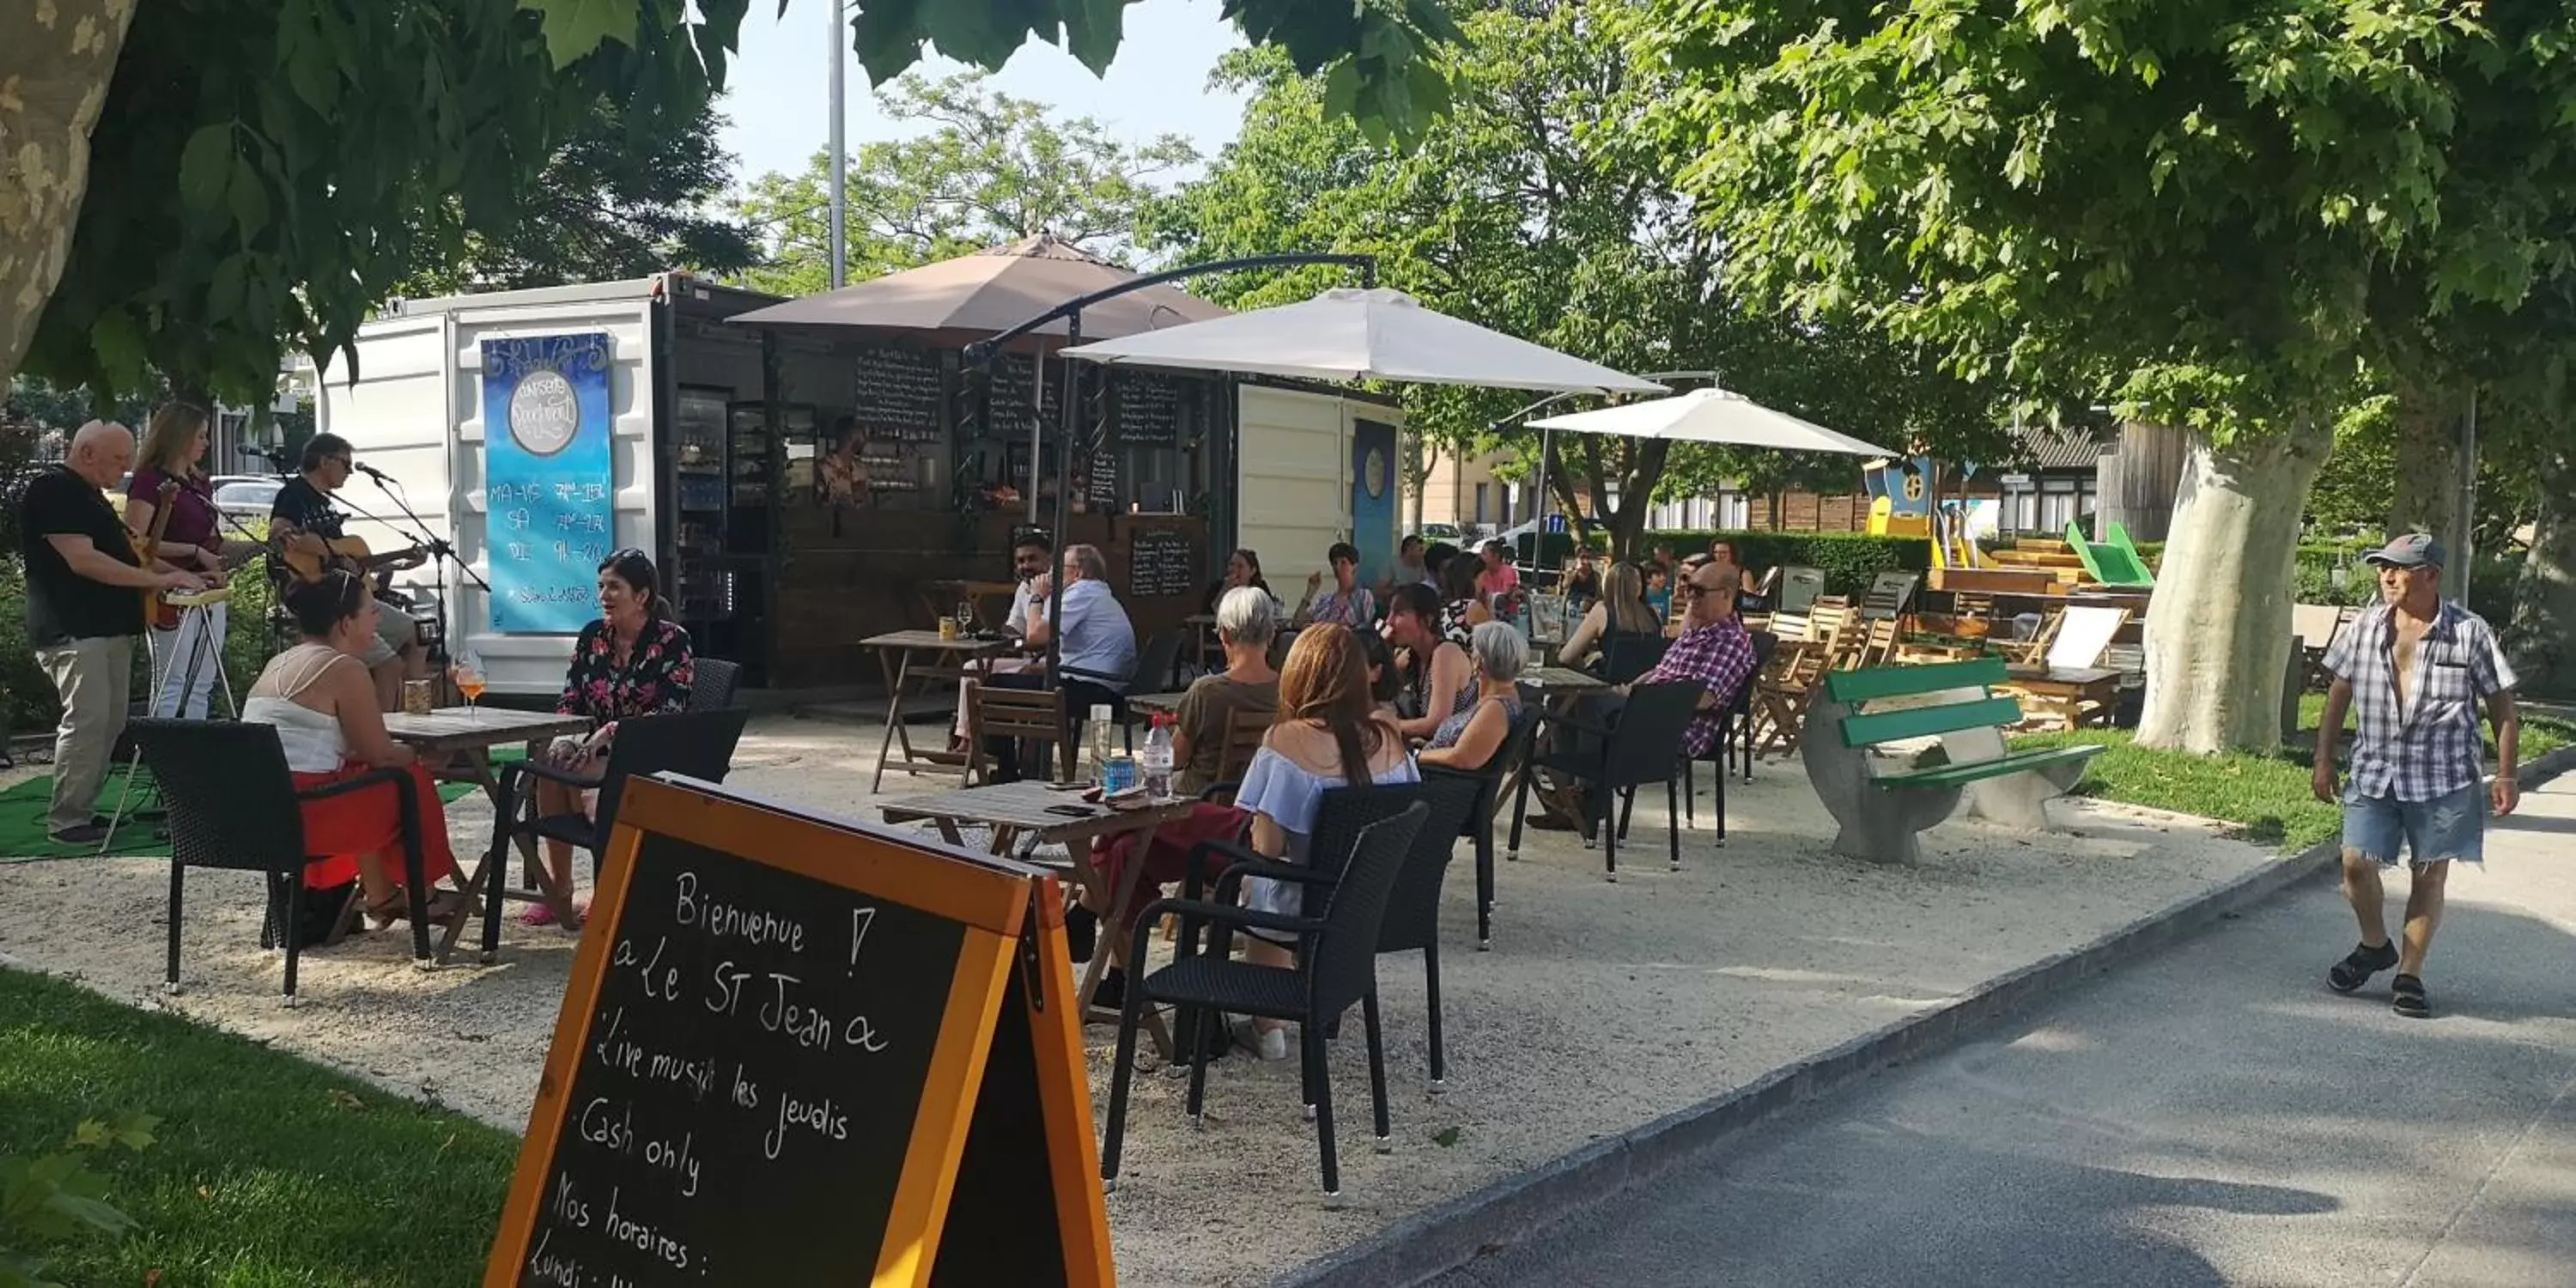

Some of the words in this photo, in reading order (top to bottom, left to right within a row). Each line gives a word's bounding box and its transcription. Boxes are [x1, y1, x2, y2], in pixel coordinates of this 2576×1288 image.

[507, 507, 530, 530] SA
[676, 871, 805, 952] Bienvenue
[847, 907, 876, 977] !
[641, 936, 679, 1001] Le
[759, 972, 831, 1052] Jean
[598, 1005, 642, 1078] Live
[732, 1062, 758, 1109] les
[764, 1091, 848, 1160] jeudis
[580, 1097, 634, 1154] Cash
[646, 1130, 700, 1197] only
[530, 1228, 583, 1288] Lundi
[553, 1170, 590, 1228] Nos
[605, 1185, 689, 1268] horaires
